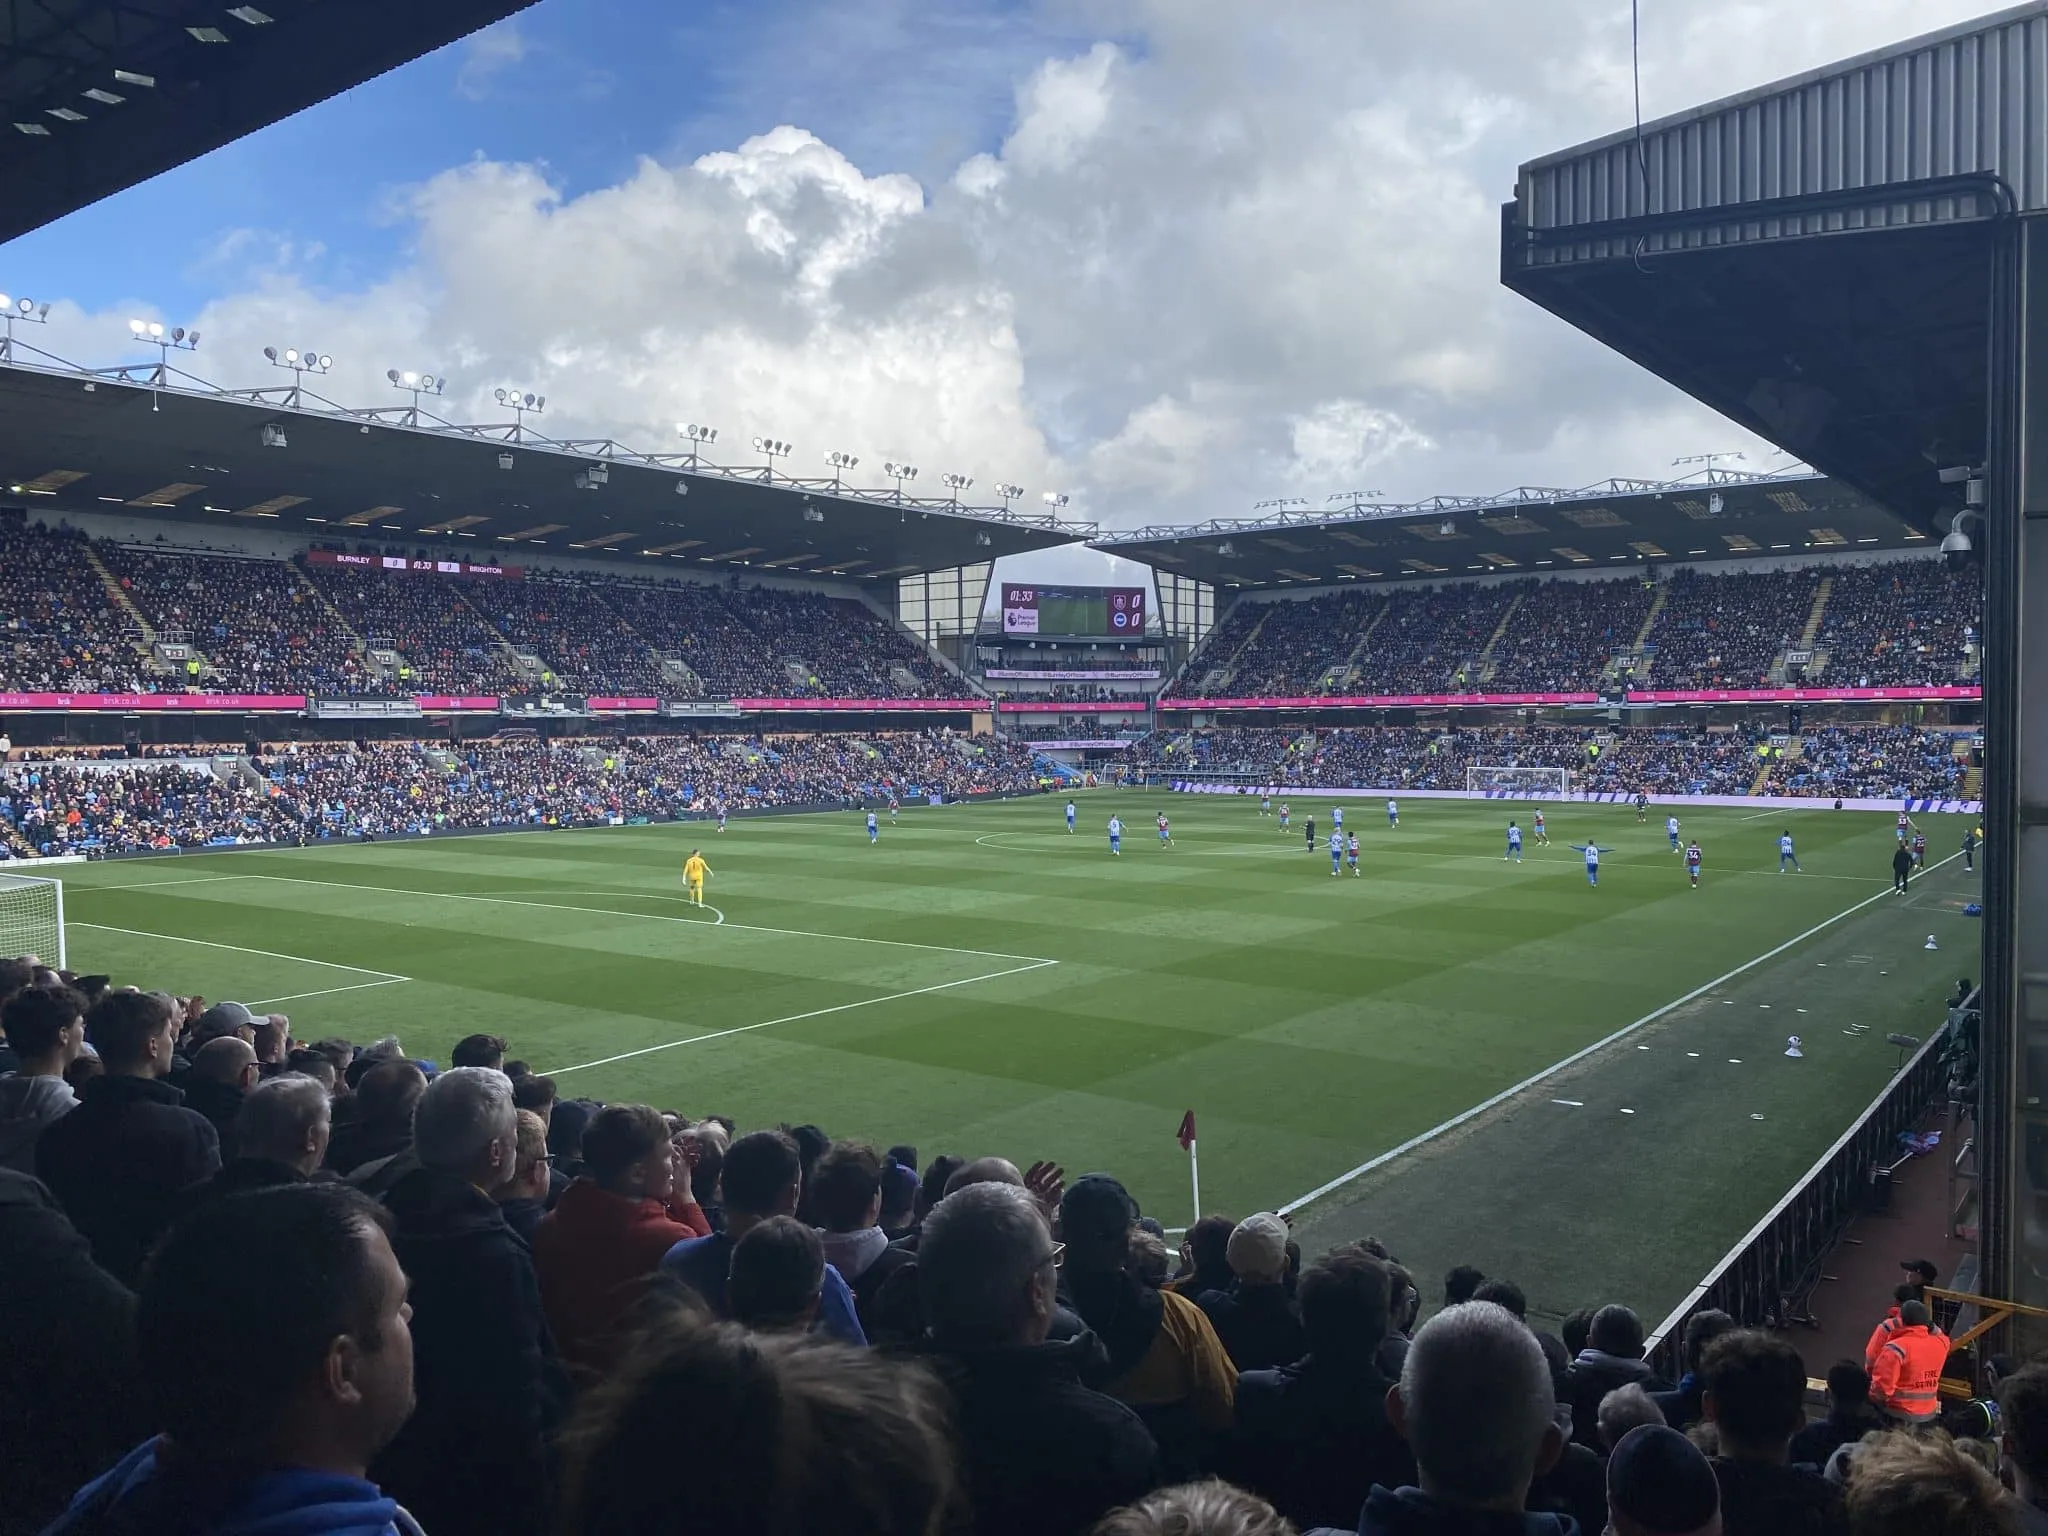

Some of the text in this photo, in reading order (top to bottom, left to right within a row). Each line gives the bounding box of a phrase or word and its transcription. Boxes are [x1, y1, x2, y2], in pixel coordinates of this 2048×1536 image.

[337, 555, 370, 563] BURNLEY
[469, 565, 502, 574] BRIGHTON
[1010, 590, 1033, 602] 01:33
[1132, 594, 1141, 608] 0
[1131, 612, 1140, 627] 0
[58, 697, 71, 705] brsk
[104, 695, 141, 705] brsk.co.uk
